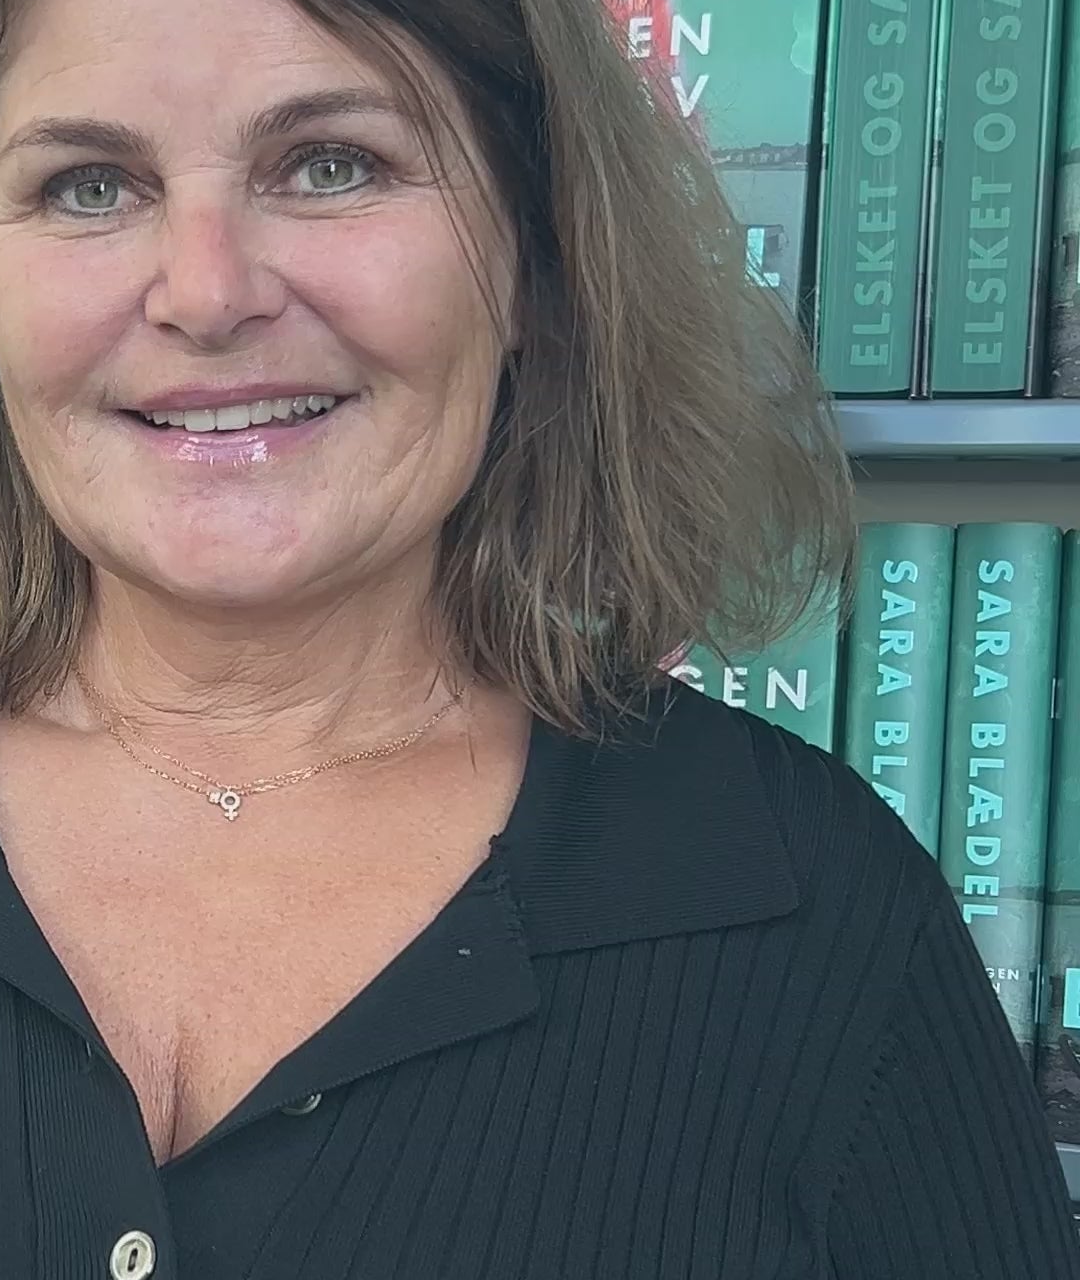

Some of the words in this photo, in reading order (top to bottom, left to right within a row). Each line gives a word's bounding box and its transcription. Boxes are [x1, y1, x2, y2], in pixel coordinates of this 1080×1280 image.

[861, 72, 904, 157] OG
[974, 68, 1019, 153] OG
[850, 179, 898, 367] ELSKET
[963, 176, 1013, 365] ELSKET
[877, 559, 919, 696] SARA
[973, 559, 1014, 697] SARA
[963, 722, 1006, 925] BLÆDEL
